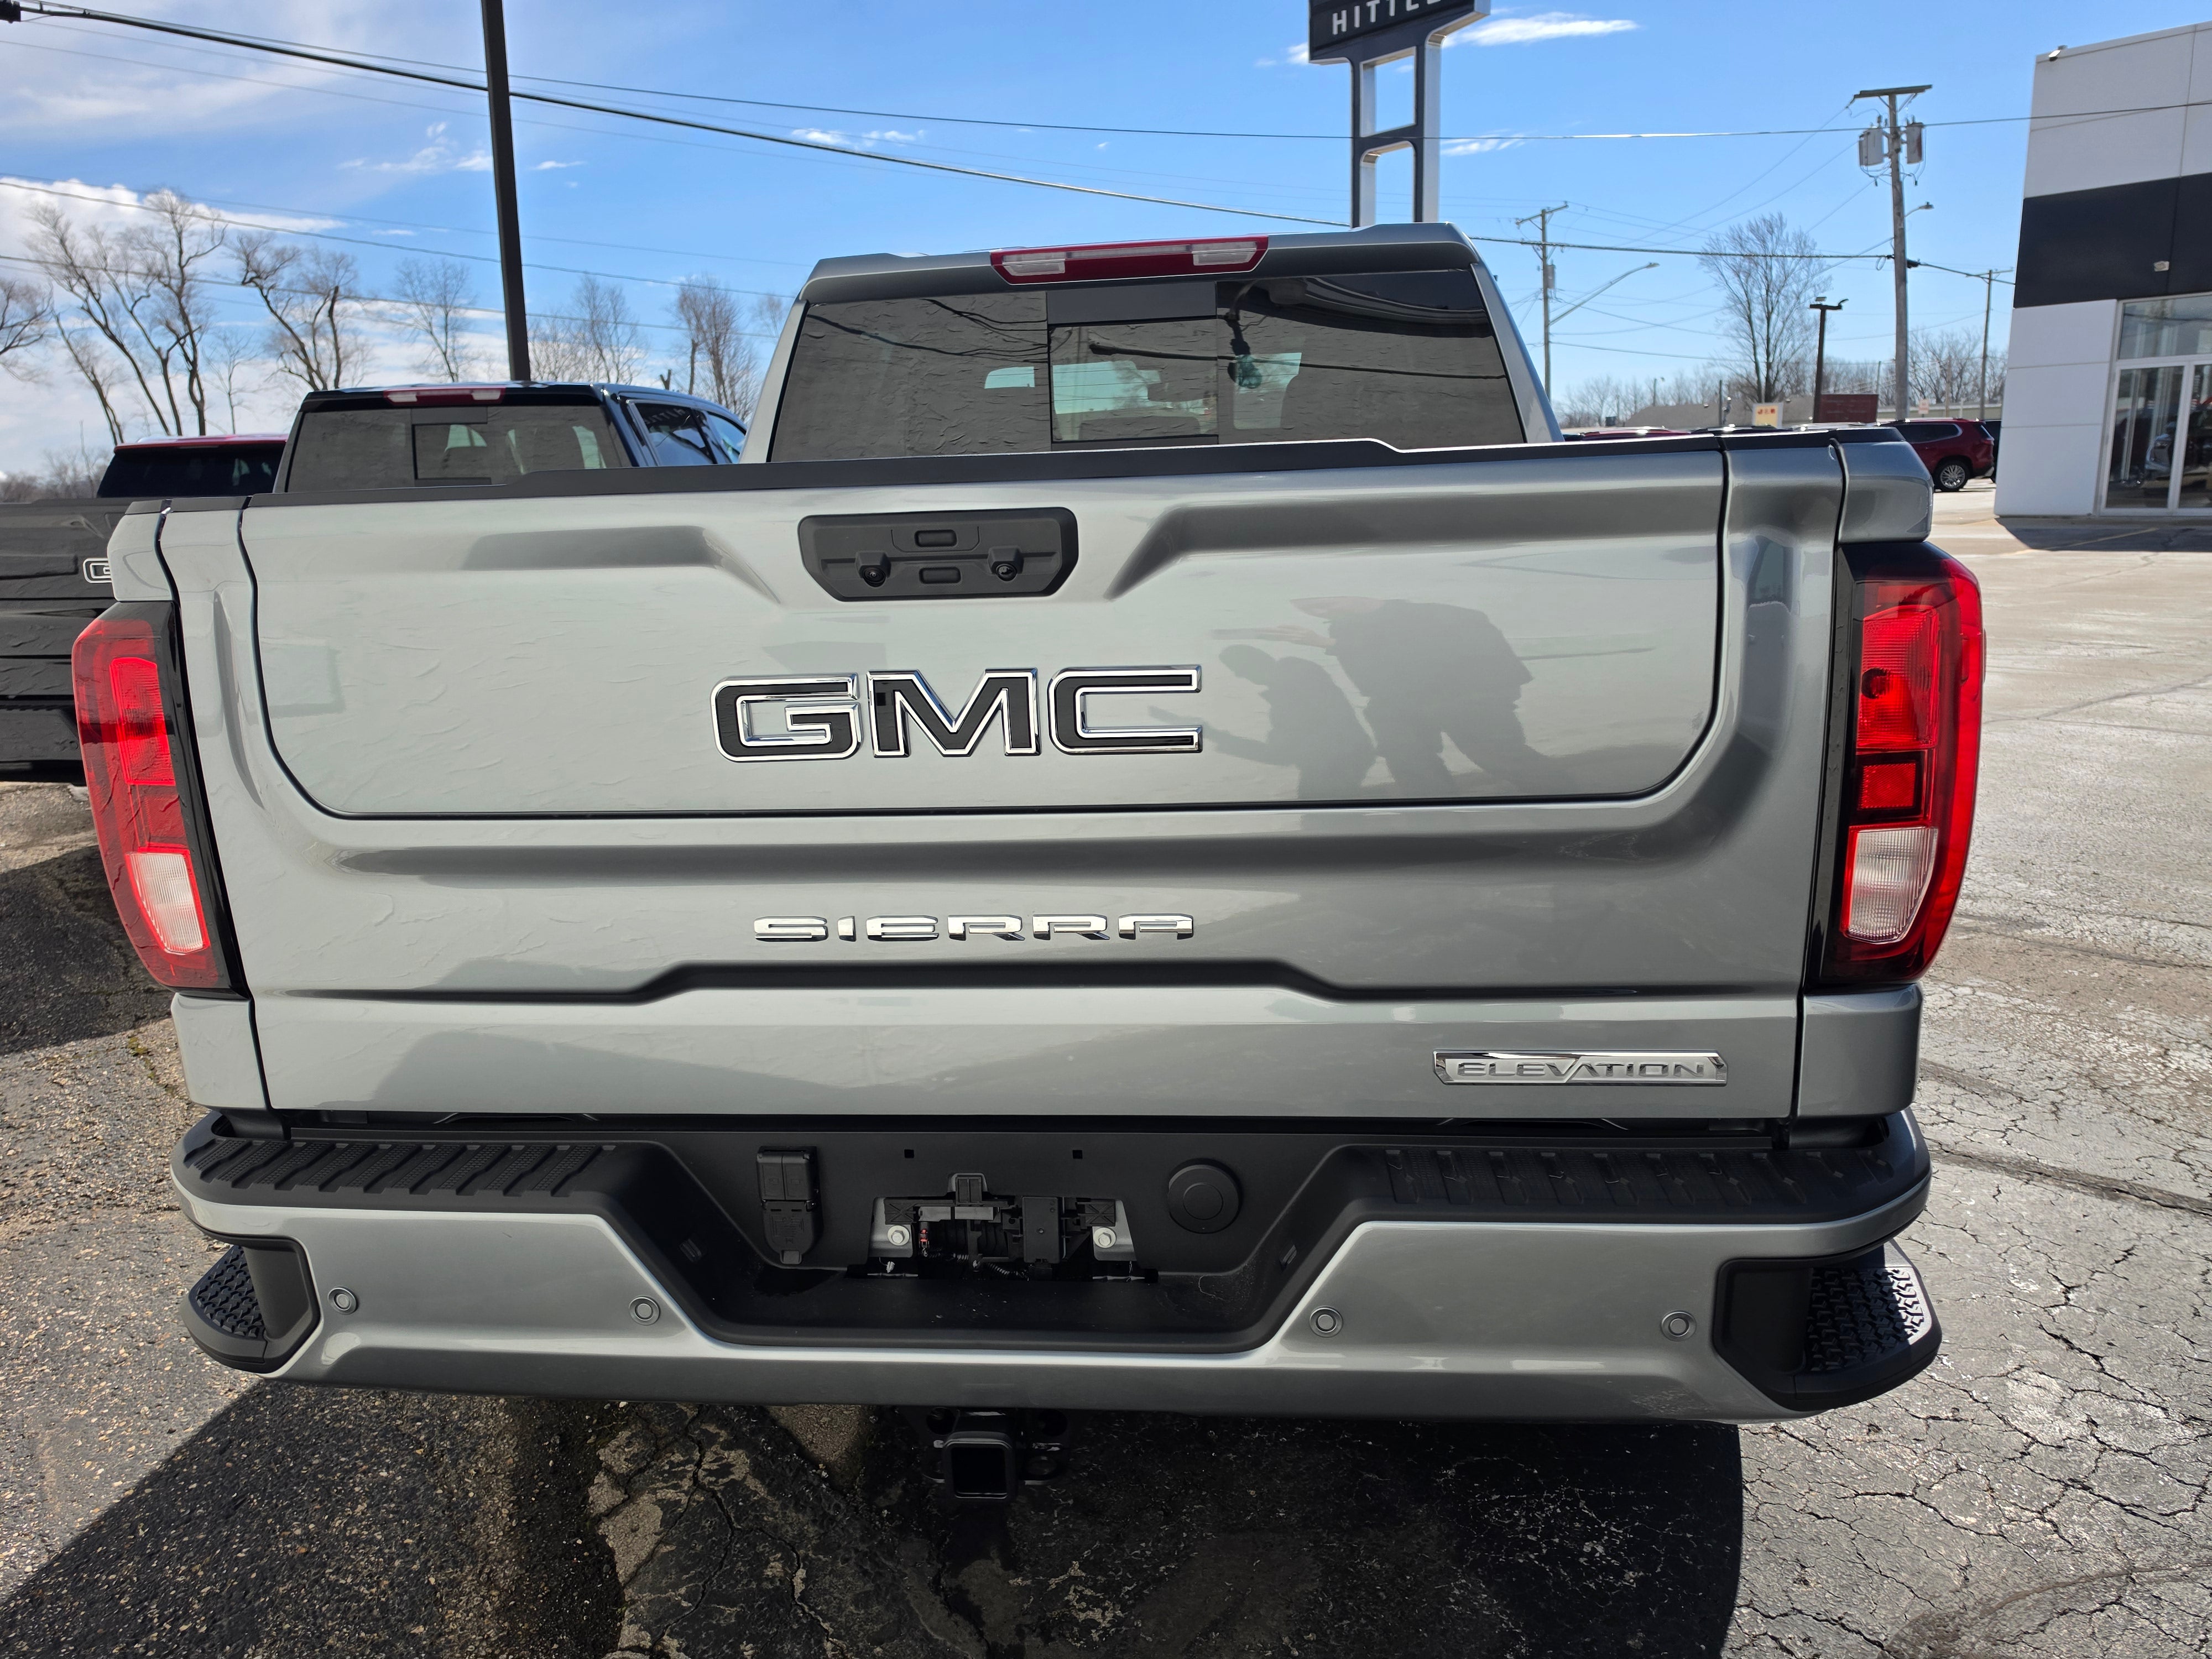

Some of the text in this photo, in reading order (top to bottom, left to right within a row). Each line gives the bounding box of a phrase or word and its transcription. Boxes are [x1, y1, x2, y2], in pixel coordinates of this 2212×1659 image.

[1332, 0, 1441, 35] HITTL
[711, 665, 1203, 762] GMC
[753, 913, 1194, 942] SIERRA
[1457, 1058, 1705, 1081] ELEVATION
